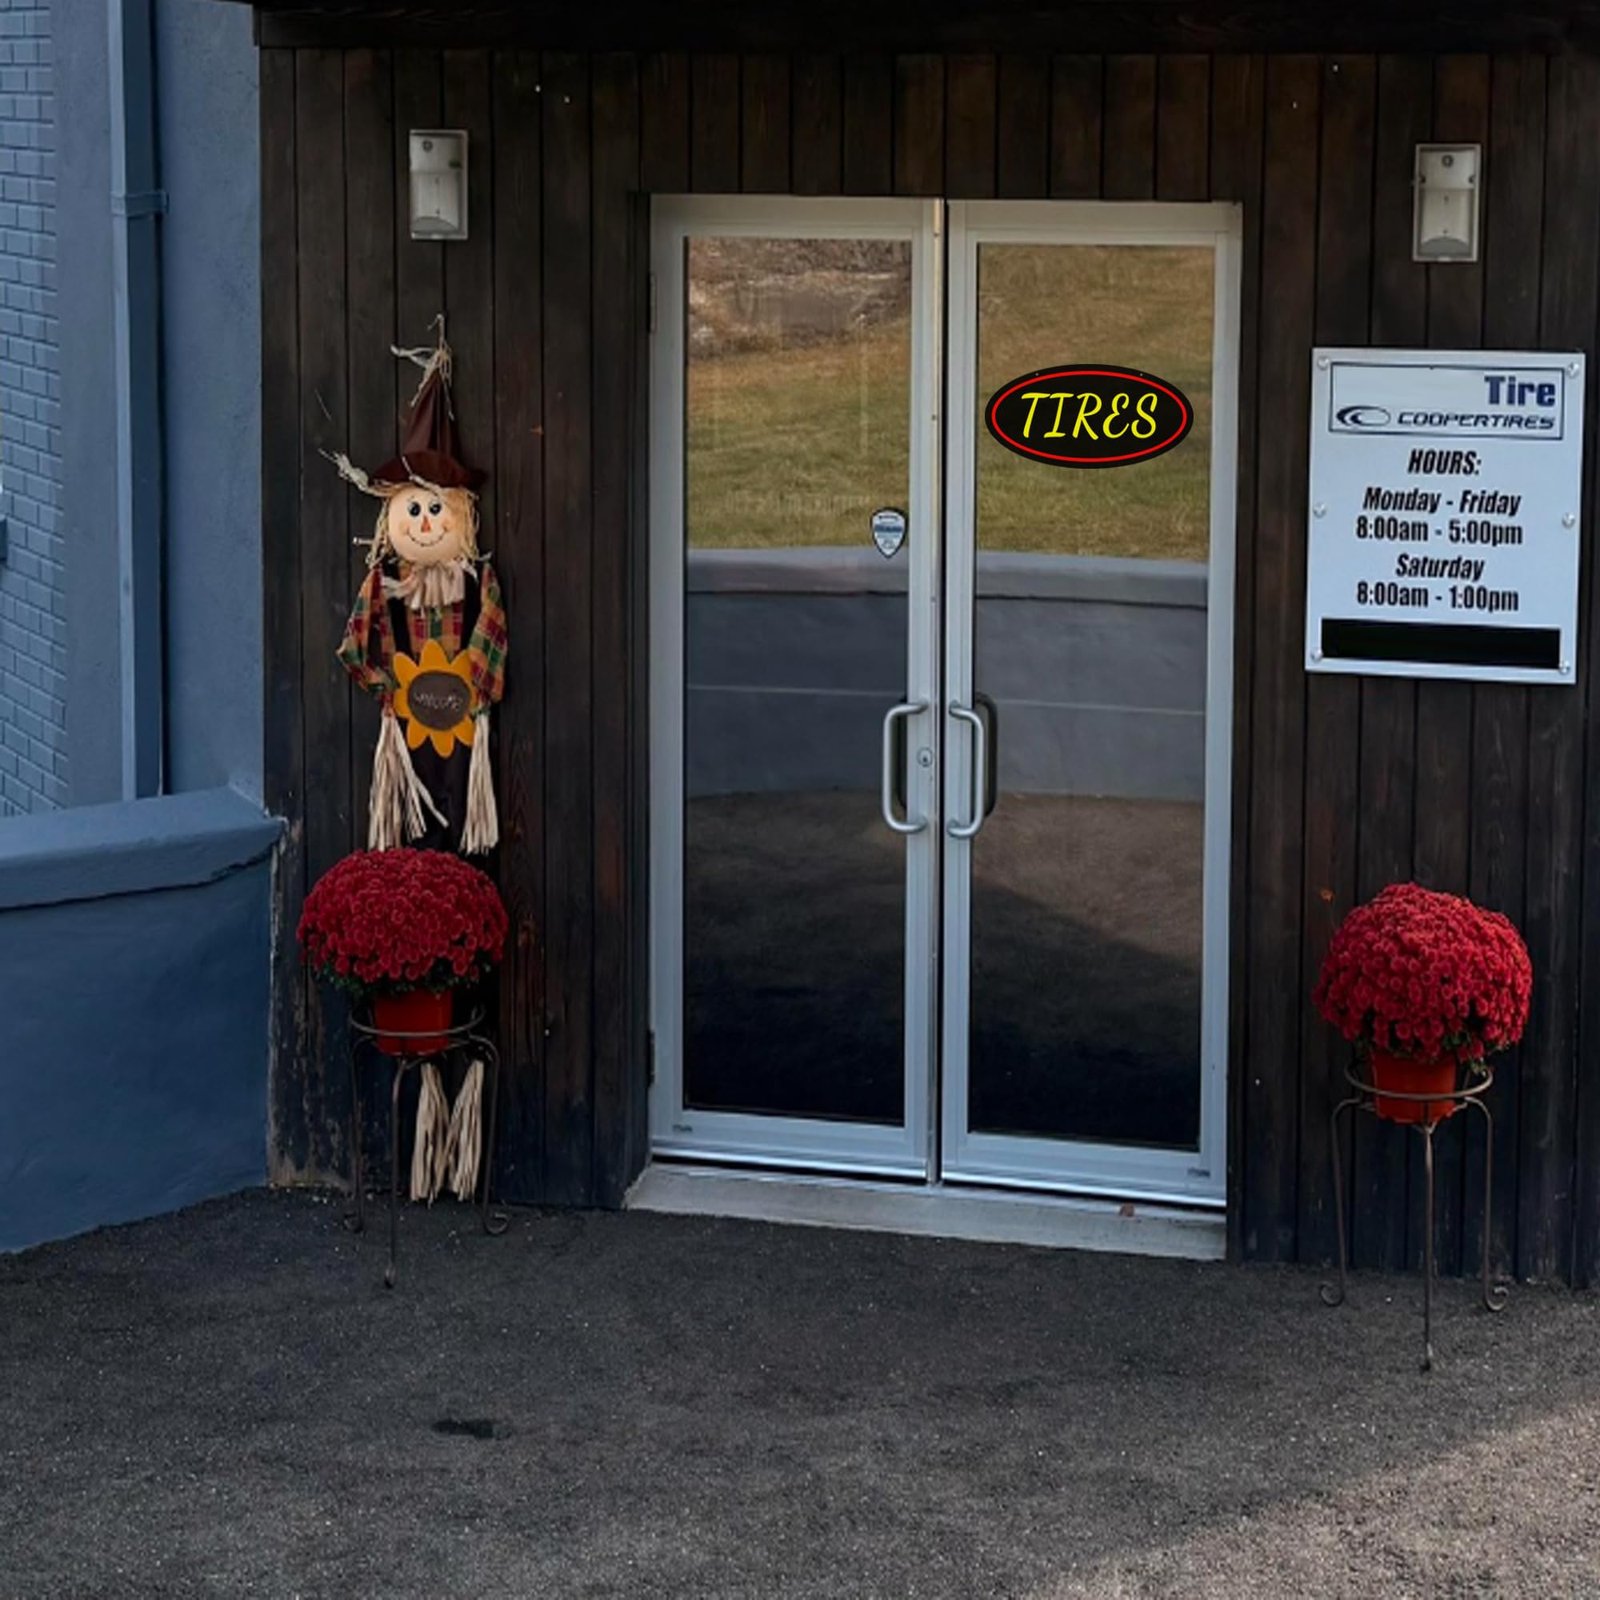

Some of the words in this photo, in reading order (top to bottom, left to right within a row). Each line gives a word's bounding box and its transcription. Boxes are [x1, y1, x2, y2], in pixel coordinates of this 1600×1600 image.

[1485, 375, 1556, 406] Tire
[1021, 392, 1158, 440] TIRES
[1408, 449, 1482, 475] HOURS:
[1362, 487, 1441, 514] Monday
[1459, 490, 1521, 516] Friday
[1356, 516, 1429, 541] 8:00am
[1448, 520, 1523, 547] 5:00pm
[1395, 553, 1485, 582] Saturday
[1356, 581, 1429, 607] 8:00am
[1449, 586, 1519, 613] 1:00pm
